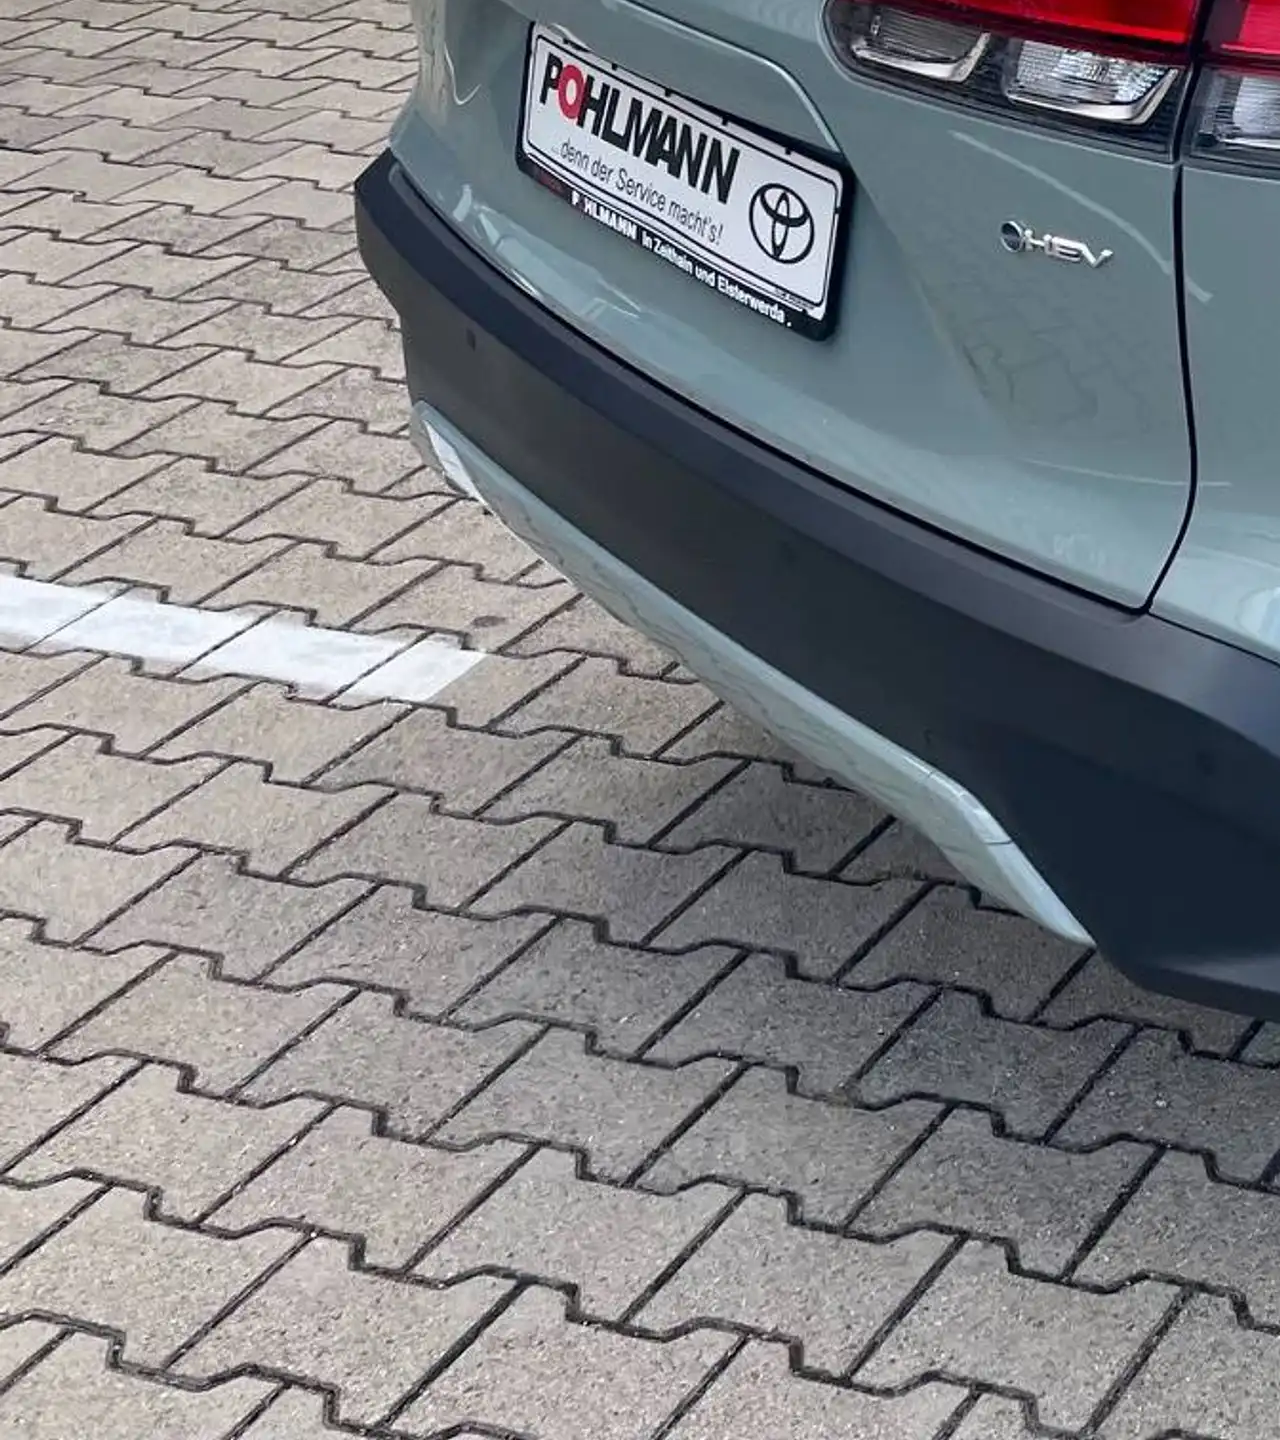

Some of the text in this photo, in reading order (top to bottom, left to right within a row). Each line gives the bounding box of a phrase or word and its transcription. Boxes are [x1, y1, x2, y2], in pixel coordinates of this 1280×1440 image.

[590, 158, 614, 183] der
[615, 167, 667, 212] Service
[694, 265, 716, 287] und
